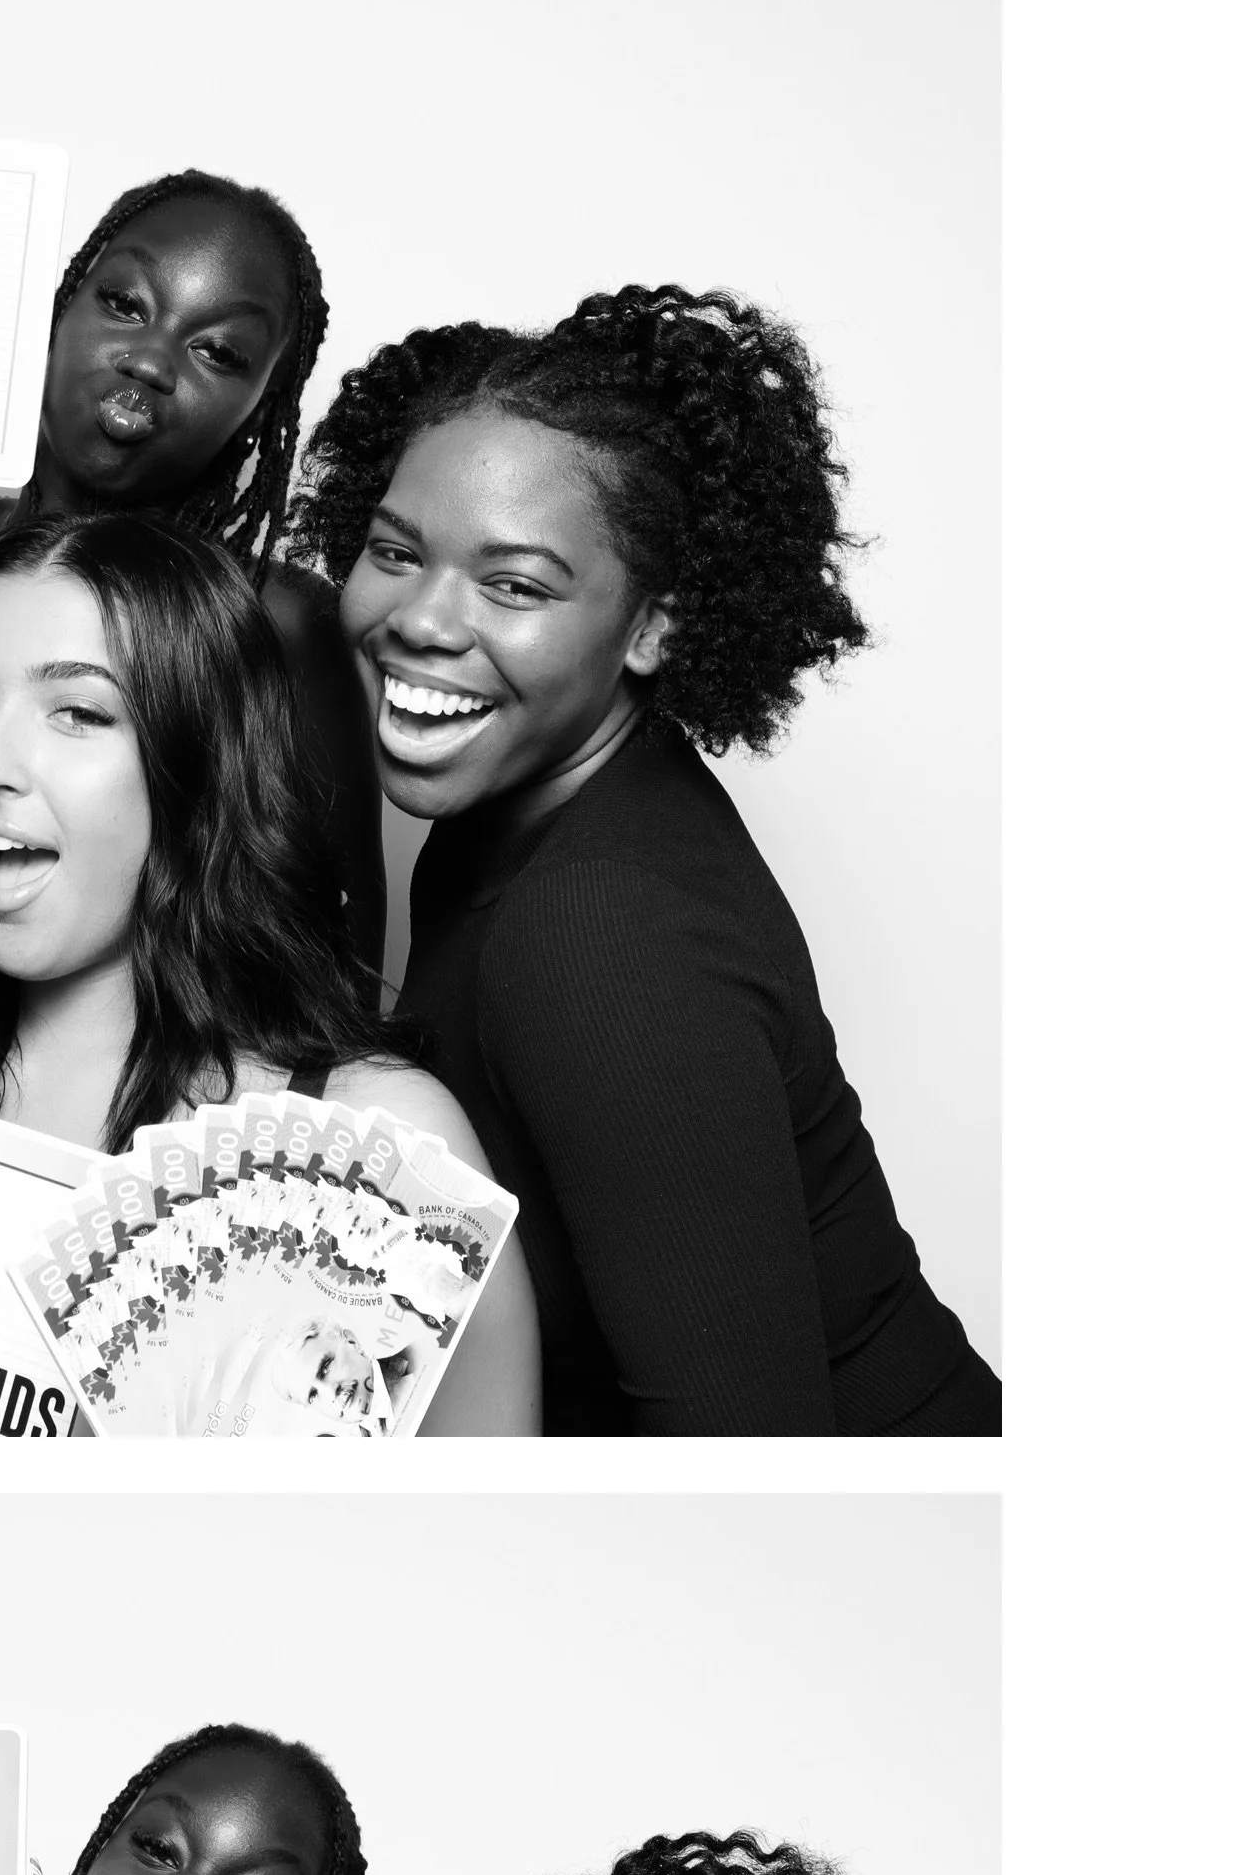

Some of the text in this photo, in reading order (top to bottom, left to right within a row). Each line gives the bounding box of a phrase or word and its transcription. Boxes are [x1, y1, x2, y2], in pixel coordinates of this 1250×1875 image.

[215, 1132, 239, 1175] 100
[252, 1119, 277, 1159] 100
[286, 1120, 312, 1162] 100
[323, 1128, 354, 1171] 100
[163, 1148, 188, 1191] 100
[262, 1166, 273, 1175] 100
[361, 1138, 394, 1180] 100
[178, 1197, 190, 1206] 100
[225, 1182, 236, 1191] 100
[116, 1180, 146, 1232] 100
[418, 1205, 443, 1215] BANK
[445, 1206, 457, 1215] OF
[457, 1210, 483, 1231] CANADA
[137, 1227, 149, 1237] 100
[39, 1264, 70, 1309] 100
[314, 1279, 337, 1299] CANADA
[337, 1294, 348, 1304] DU
[349, 1296, 383, 1307] BANQUE
